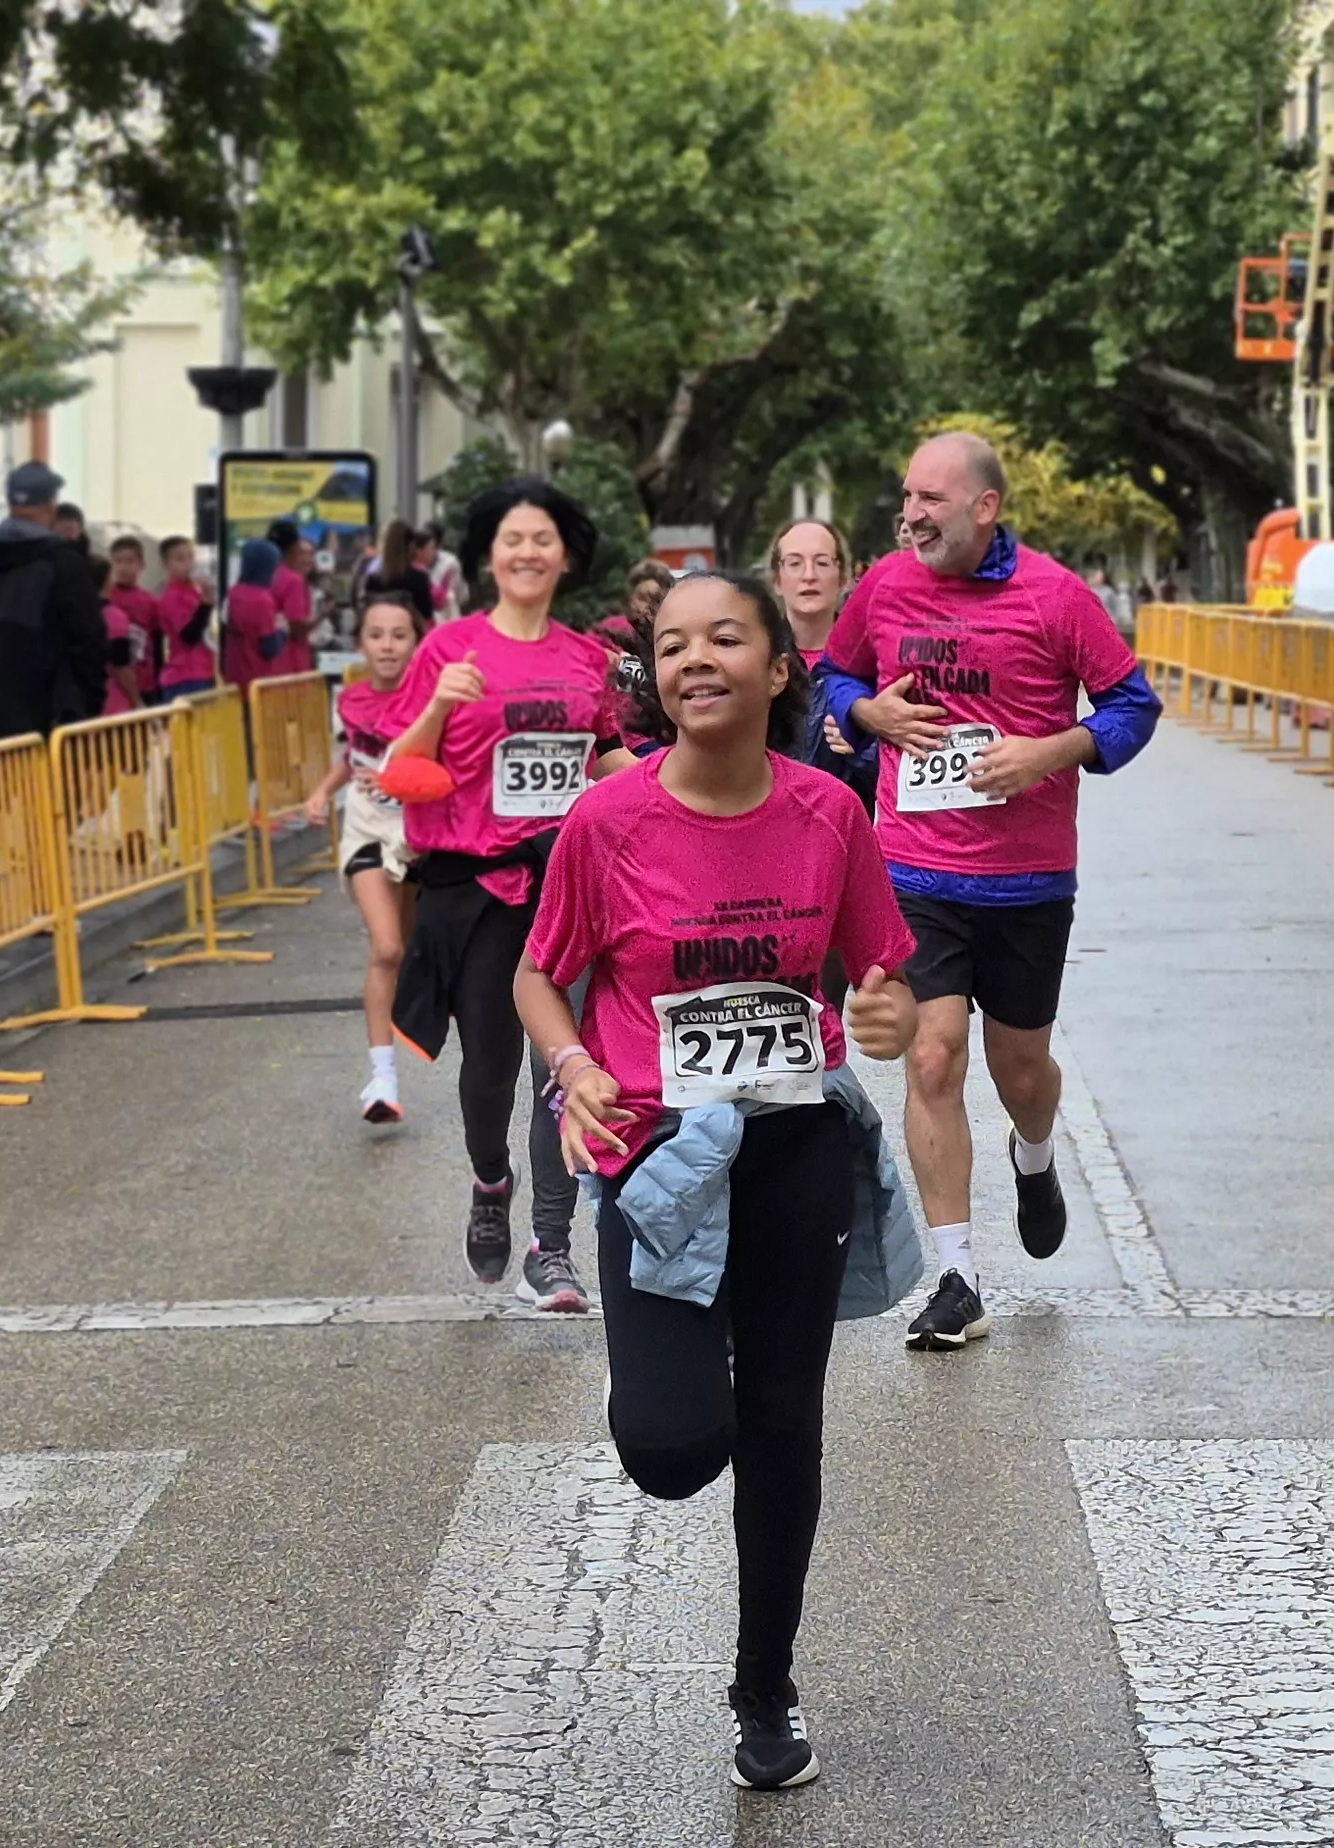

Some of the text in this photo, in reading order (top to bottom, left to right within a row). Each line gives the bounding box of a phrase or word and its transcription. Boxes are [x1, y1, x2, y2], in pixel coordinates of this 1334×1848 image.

[506, 760, 580, 791] 3992
[673, 934, 780, 980] UNIDOS
[679, 1001, 802, 1024] CONTRA EL CÁNCER
[723, 995, 761, 1009] HUESCA
[679, 1021, 812, 1076] 2775
